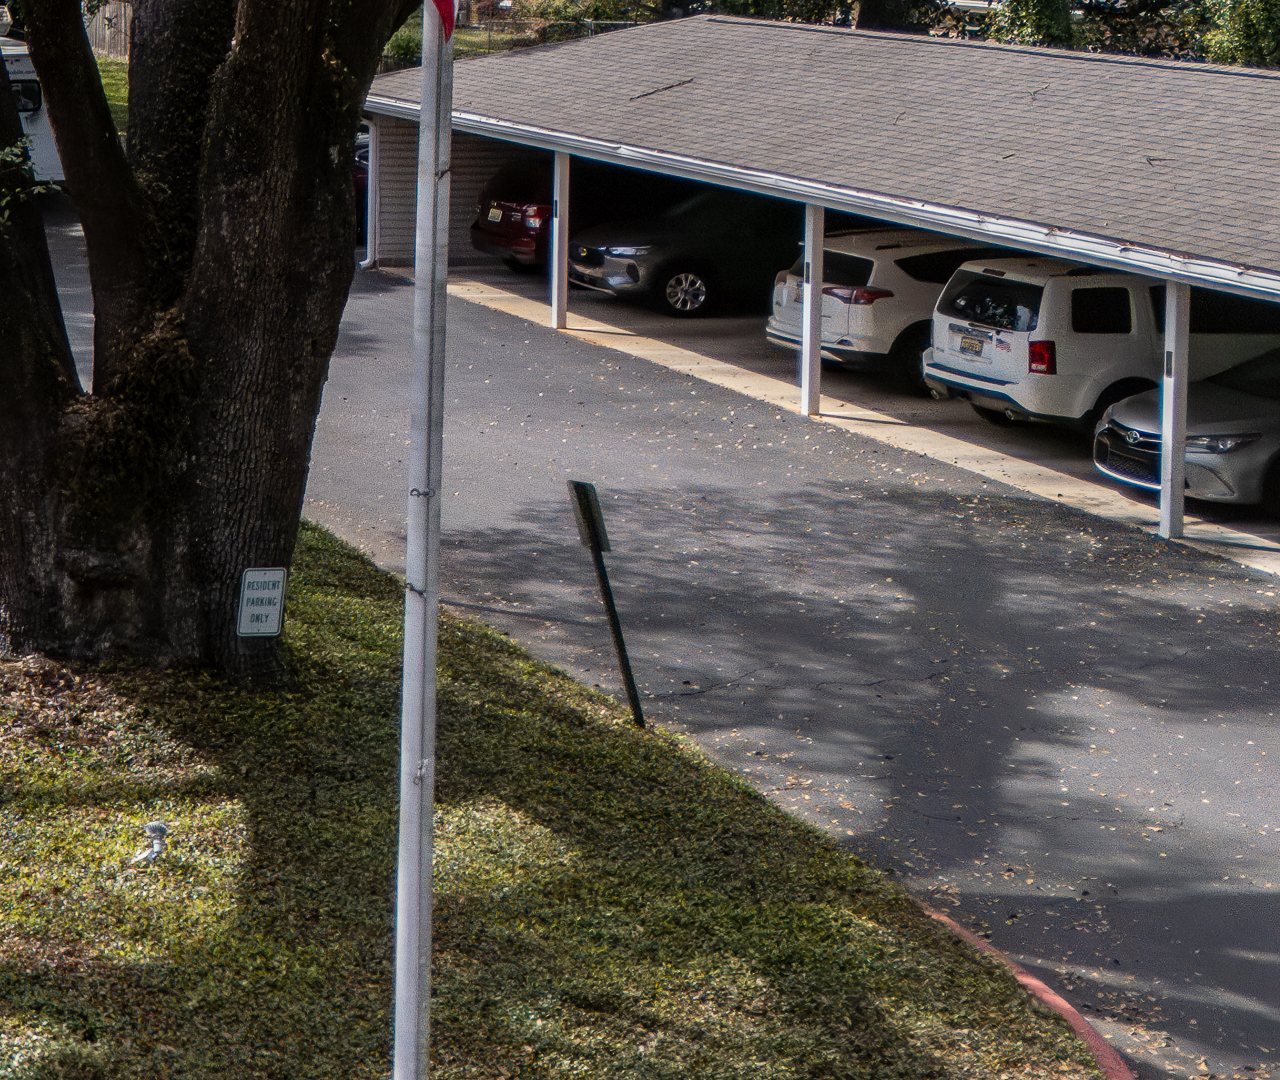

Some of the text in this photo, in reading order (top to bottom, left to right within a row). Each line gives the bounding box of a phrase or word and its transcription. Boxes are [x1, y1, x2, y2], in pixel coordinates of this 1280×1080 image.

[247, 581, 281, 591] RESIDENT
[246, 597, 277, 607] PARKING
[250, 613, 269, 623] ONLY
